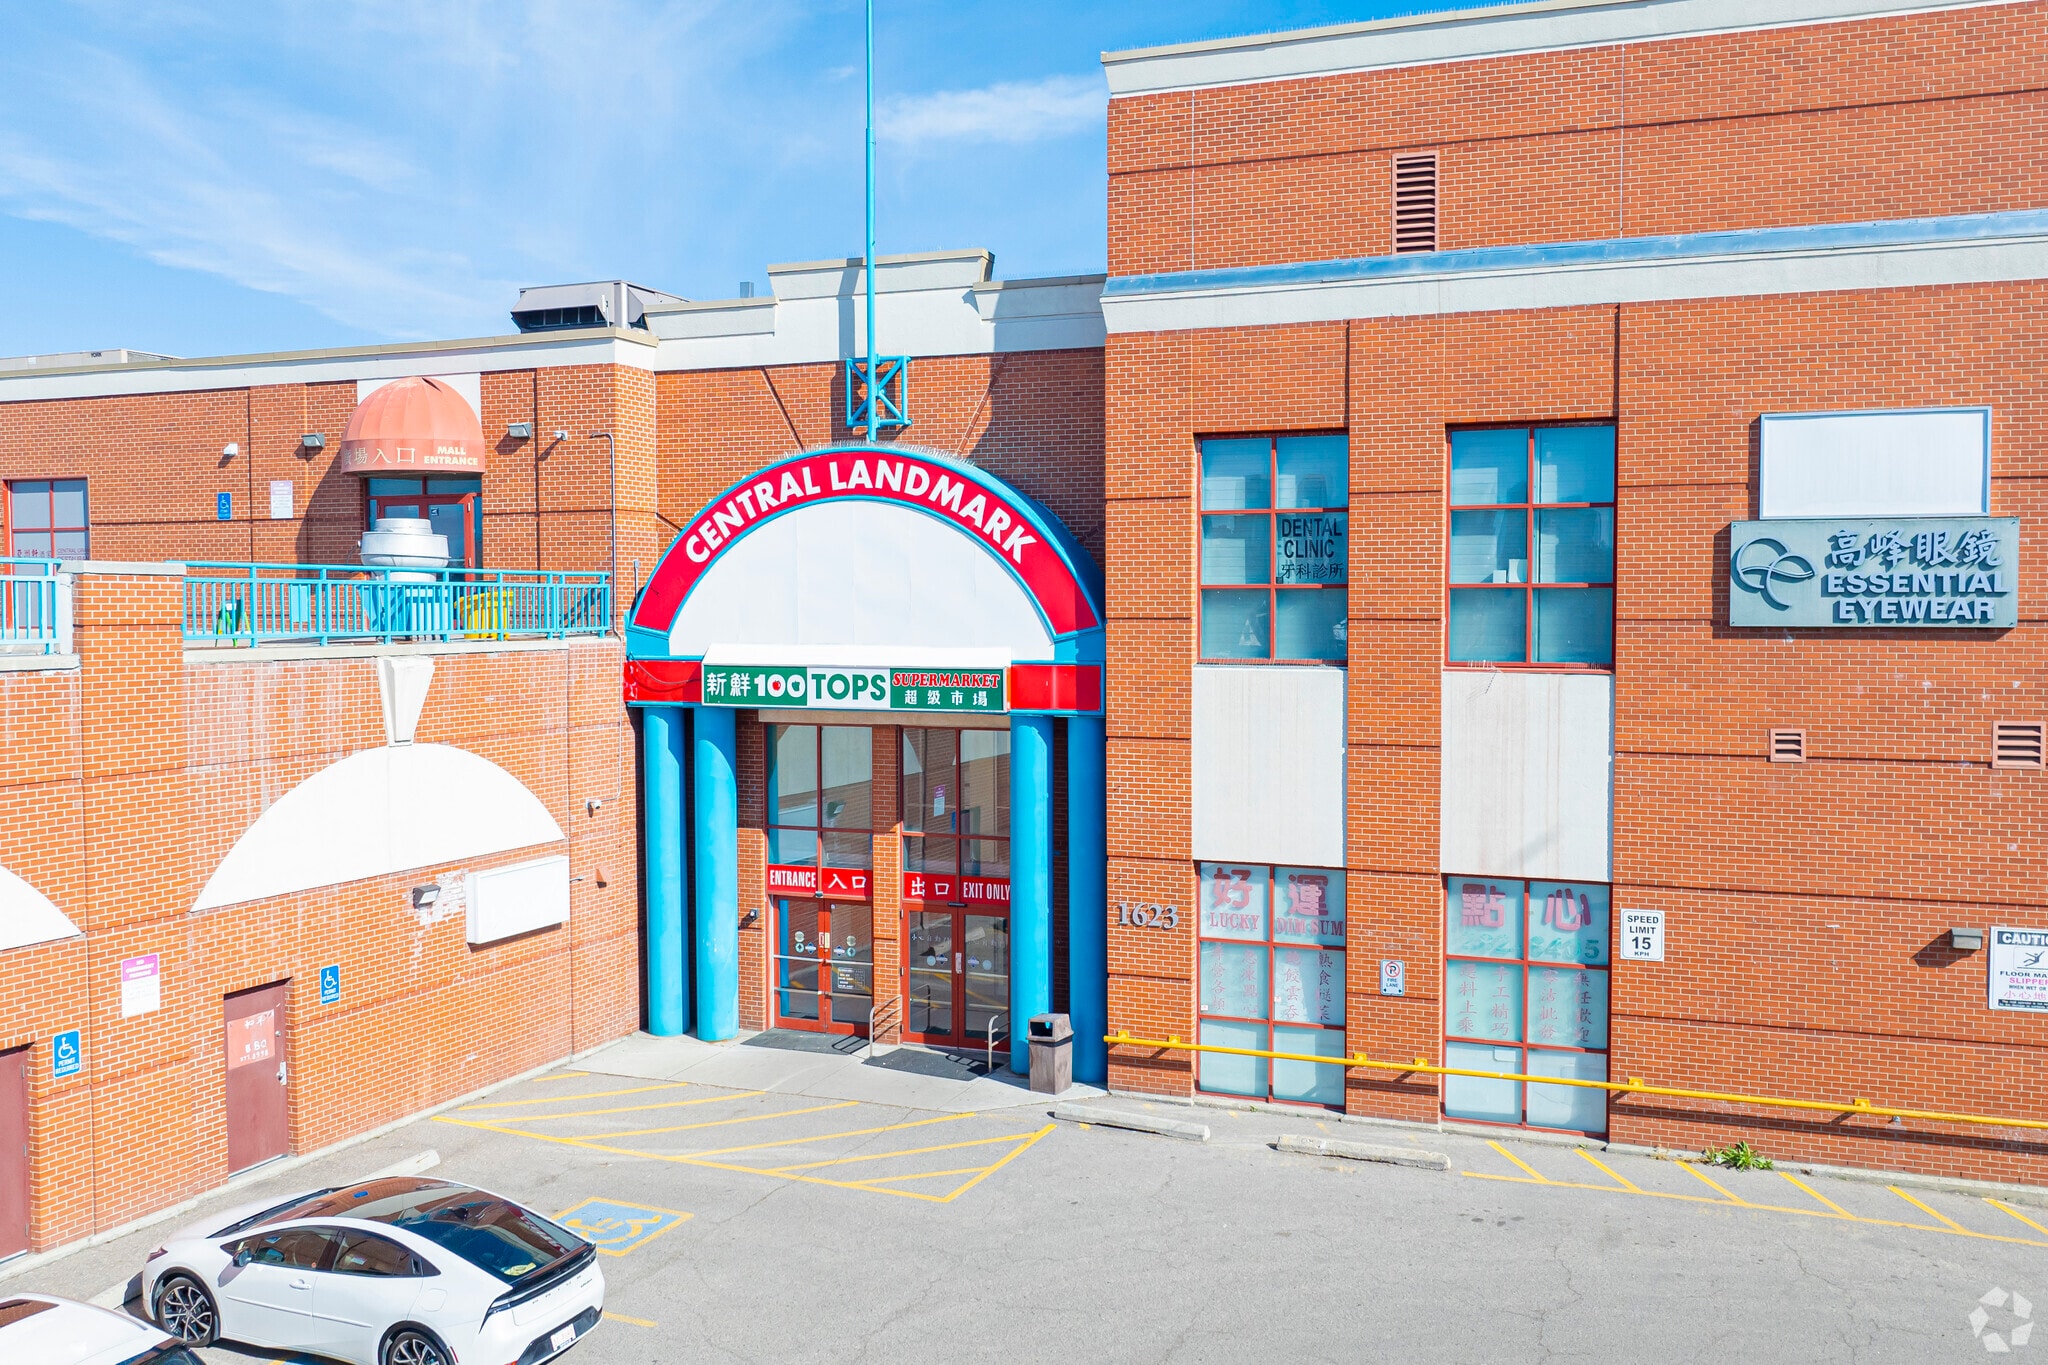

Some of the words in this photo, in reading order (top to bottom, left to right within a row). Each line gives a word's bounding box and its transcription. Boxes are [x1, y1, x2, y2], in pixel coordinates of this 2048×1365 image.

[437, 446, 466, 455] MALL
[424, 455, 479, 466] ENTRANCE
[685, 466, 821, 563] CENTRAL
[829, 459, 1037, 565] LANDMARK
[1281, 518, 1342, 537] DENTAL
[1284, 539, 1334, 558] CLINIC
[1831, 528, 2003, 568] 高峰眼鏡
[1281, 563, 1344, 579] 牙科診所
[1828, 571, 2012, 593] ESSENTIAL
[1839, 597, 1995, 619] EYEWEAR
[707, 672, 751, 697] 新鮮
[754, 674, 806, 698] 100
[811, 673, 886, 701] TOPS
[892, 672, 1000, 688] SUPERMARKET
[905, 690, 987, 707] 超級市場
[769, 870, 816, 888] ENTRANCE
[828, 873, 867, 890] 入口
[911, 876, 950, 897] 出口
[963, 882, 984, 899] EXIT
[986, 883, 1010, 900] ONLY
[1213, 867, 1329, 916] 好運
[1119, 902, 1179, 928] 1623
[1461, 883, 1592, 931] 點心
[1210, 912, 1260, 930] LUCKY
[1276, 917, 1307, 935] DIM
[1311, 919, 1344, 936] SUM
[1627, 915, 1659, 924] SPEED
[1629, 926, 1656, 934] LIMIT
[2002, 932, 2048, 946] CAUTI
[1632, 936, 1651, 950] 15
[1999, 970, 2030, 978] FLOOR
